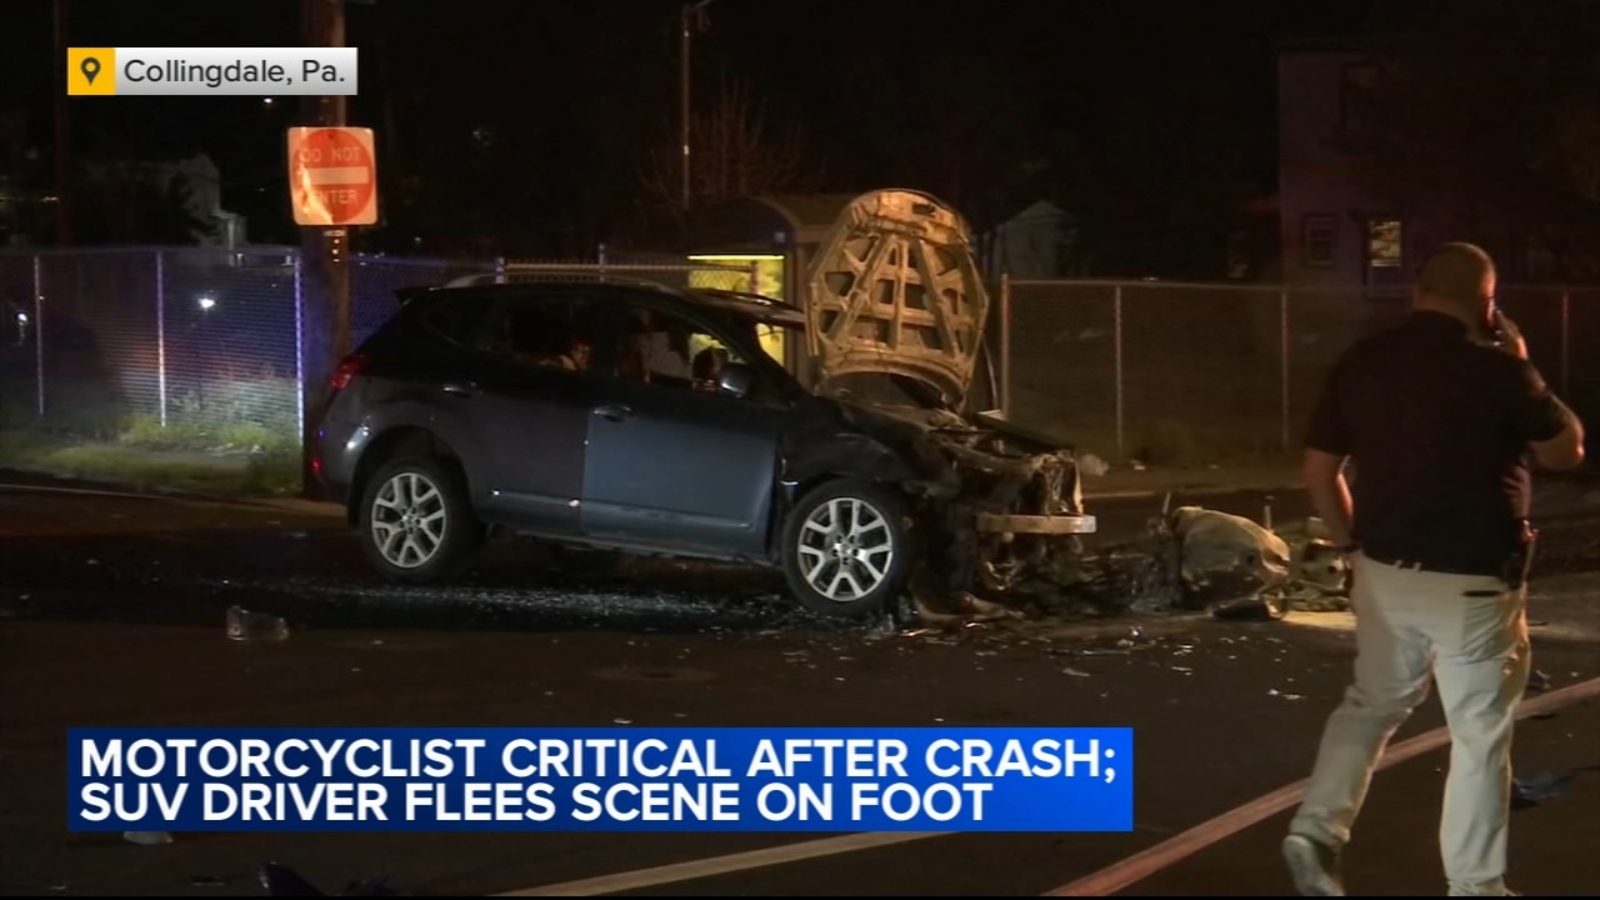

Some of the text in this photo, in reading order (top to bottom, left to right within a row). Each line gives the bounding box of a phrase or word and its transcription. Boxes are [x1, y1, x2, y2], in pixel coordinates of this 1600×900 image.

[300, 146, 361, 163] DO NOT
[309, 189, 359, 205] NTER
